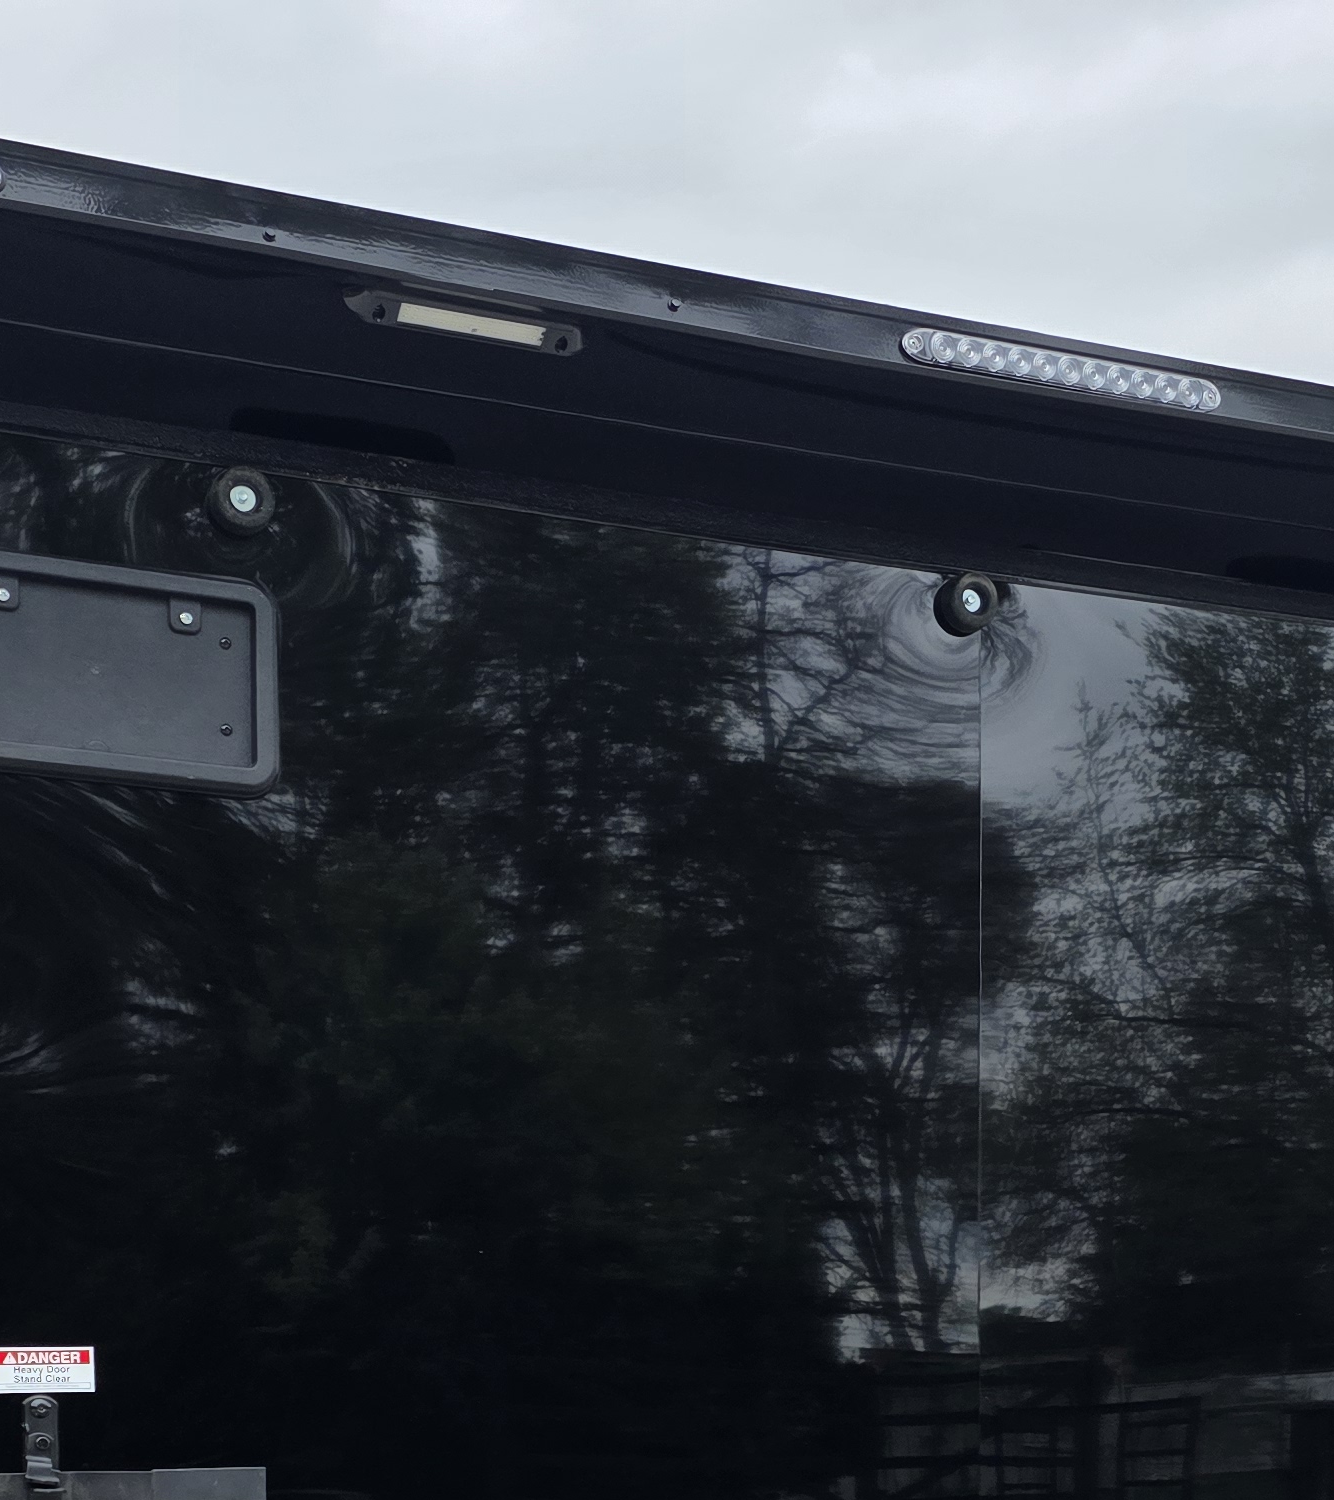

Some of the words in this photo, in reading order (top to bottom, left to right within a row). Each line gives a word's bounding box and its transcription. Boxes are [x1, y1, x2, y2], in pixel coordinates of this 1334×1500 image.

[17, 1351, 81, 1364] DANGER
[13, 1366, 43, 1376] Heavy
[46, 1365, 71, 1373] Door
[13, 1375, 42, 1383] Stand
[45, 1375, 71, 1383] Clear
